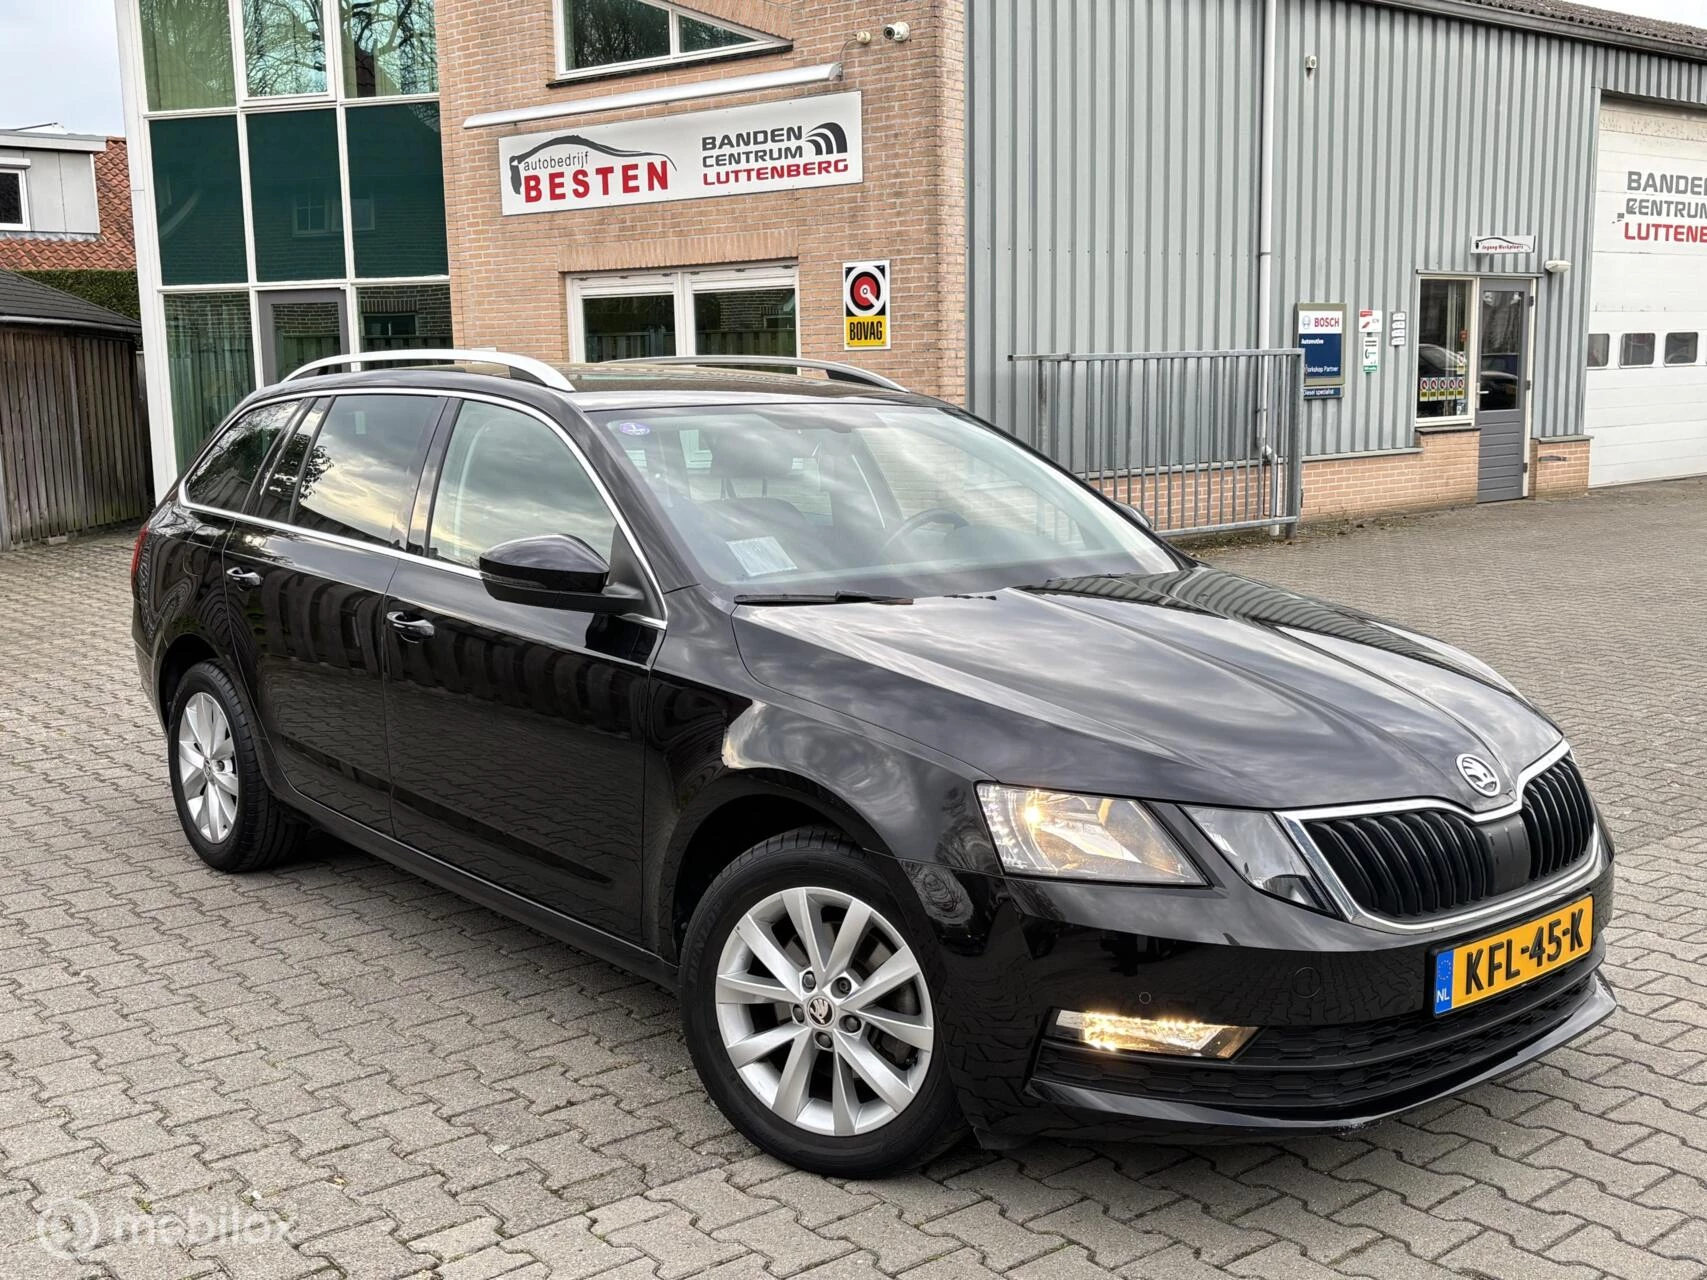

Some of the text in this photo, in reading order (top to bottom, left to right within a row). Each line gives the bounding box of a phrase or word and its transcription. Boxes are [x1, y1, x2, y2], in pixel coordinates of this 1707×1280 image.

[702, 125, 803, 151] BANDEN
[523, 151, 590, 172] autobedrijf
[702, 145, 803, 168] CENTRUM
[524, 160, 669, 203] BESTEN
[703, 158, 849, 186] LUTTENBERG
[849, 321, 883, 341] BOVAG
[1314, 317, 1340, 328] BOSCH
[1465, 908, 1584, 995] KFL-45-K
[1436, 987, 1450, 1003] NL
